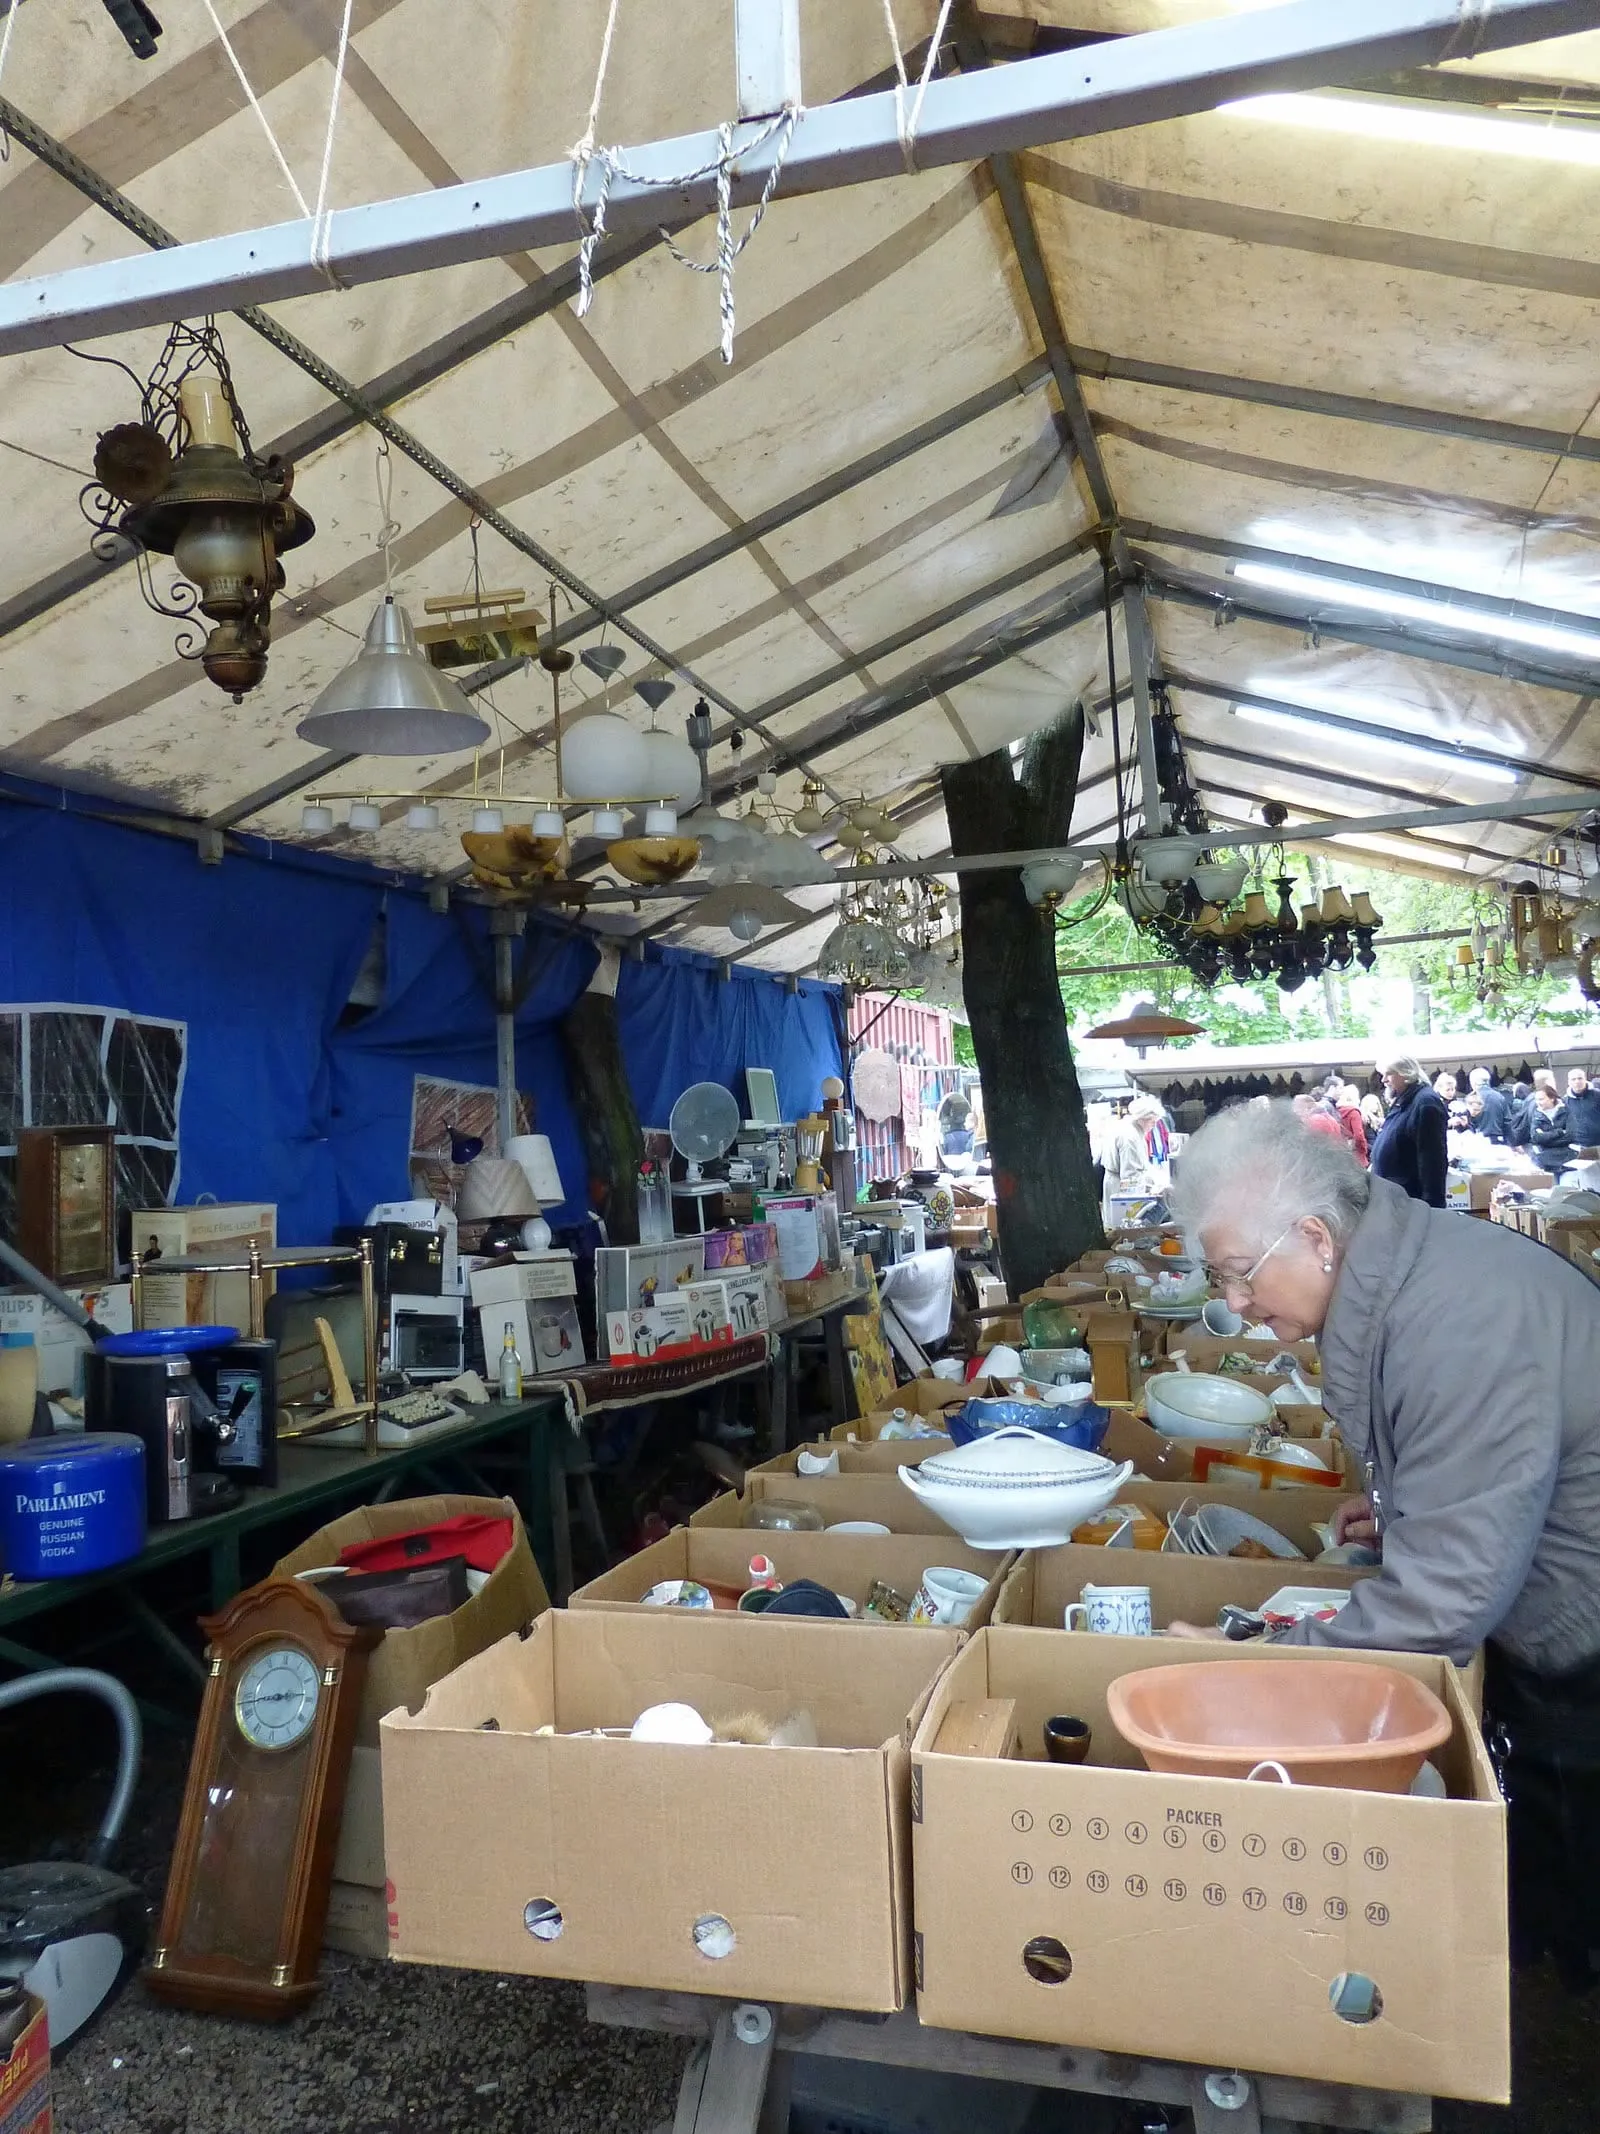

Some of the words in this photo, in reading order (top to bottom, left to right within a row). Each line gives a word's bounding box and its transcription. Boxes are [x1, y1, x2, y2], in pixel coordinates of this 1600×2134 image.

[0, 1299, 34, 1313] ILIPS
[16, 1490, 106, 1513] PARLIAMENT
[39, 1517, 85, 1531] GENUINE
[40, 1531, 85, 1544] RUSSIAN
[40, 1546, 75, 1558] VODKA
[1166, 1808, 1223, 1827] PACKER
